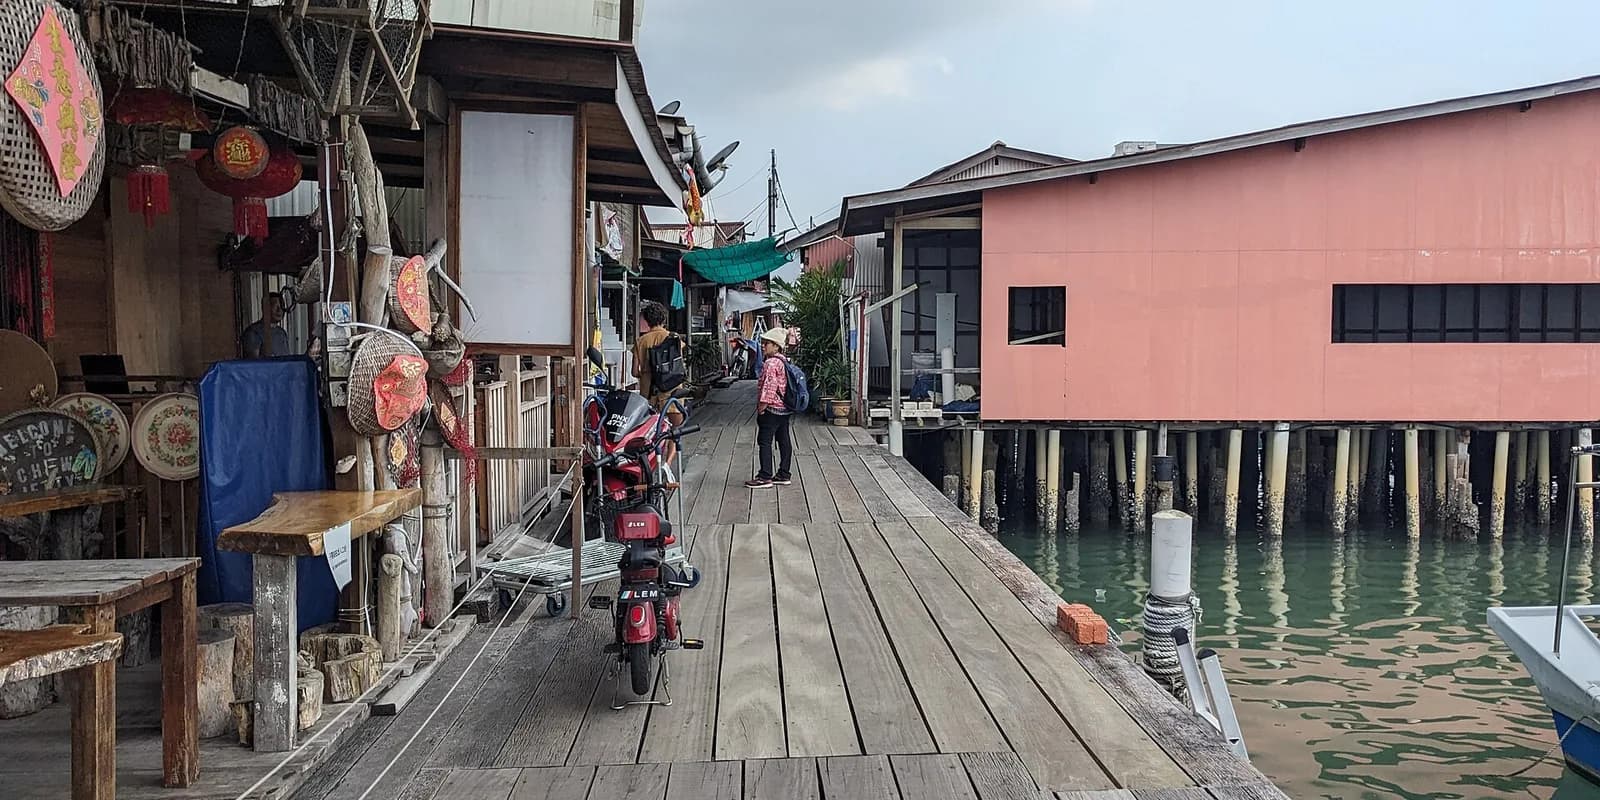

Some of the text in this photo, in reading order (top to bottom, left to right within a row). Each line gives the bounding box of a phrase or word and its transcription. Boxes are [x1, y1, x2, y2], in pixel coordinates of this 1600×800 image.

[611, 413, 628, 423] PNX
[31, 441, 52, 459] TO
[16, 456, 73, 483] CHEW
[634, 590, 658, 598] LEM
